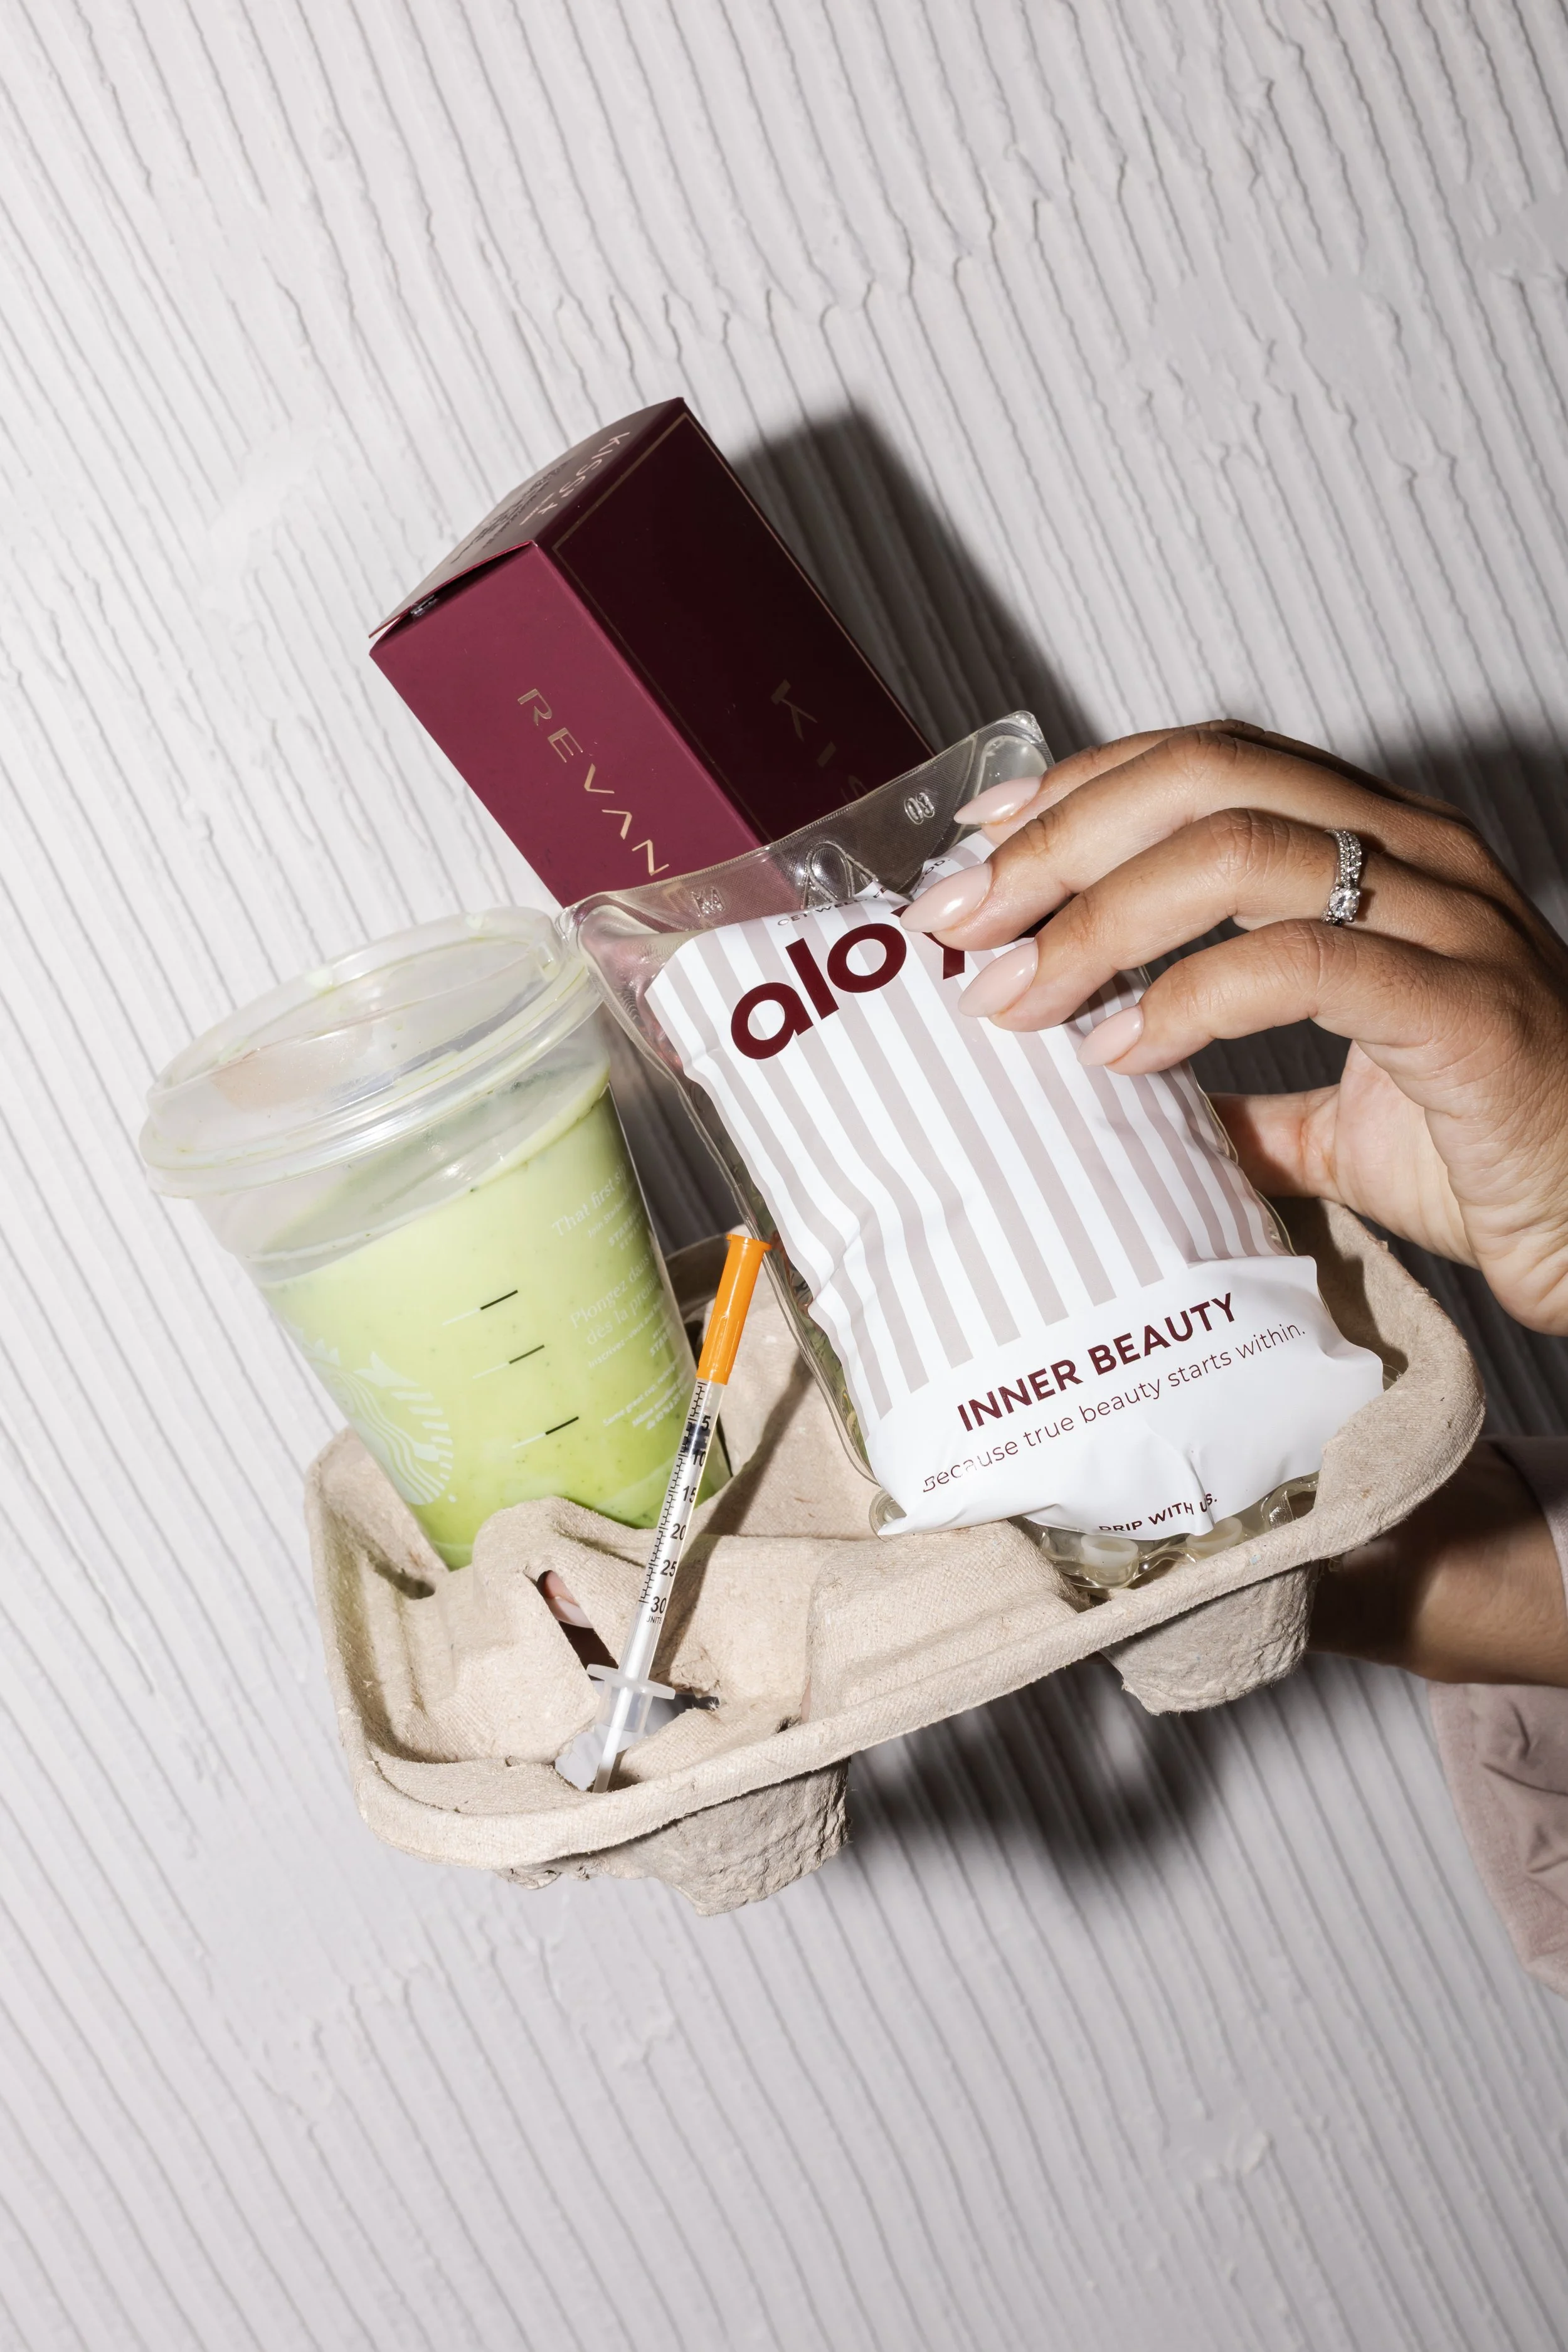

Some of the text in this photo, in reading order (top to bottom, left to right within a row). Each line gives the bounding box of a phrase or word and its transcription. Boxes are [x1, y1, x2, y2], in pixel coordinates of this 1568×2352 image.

[551, 1202, 591, 1237] That
[591, 1177, 615, 1209] first
[569, 1279, 627, 1330] Plongez
[957, 1292, 1236, 1432] INNER BEAUTY
[1023, 1416, 1075, 1448] true
[1079, 1378, 1162, 1424] beauty
[1167, 1349, 1232, 1388] starts
[1235, 1323, 1306, 1360] within.
[693, 1448, 706, 1467] 10
[682, 1485, 697, 1503] 15
[1098, 1520, 1143, 1532] DRIP
[1148, 1502, 1195, 1525] WITH
[670, 1523, 687, 1541] 20
[660, 1559, 677, 1577] 25
[650, 1596, 667, 1614] 30
